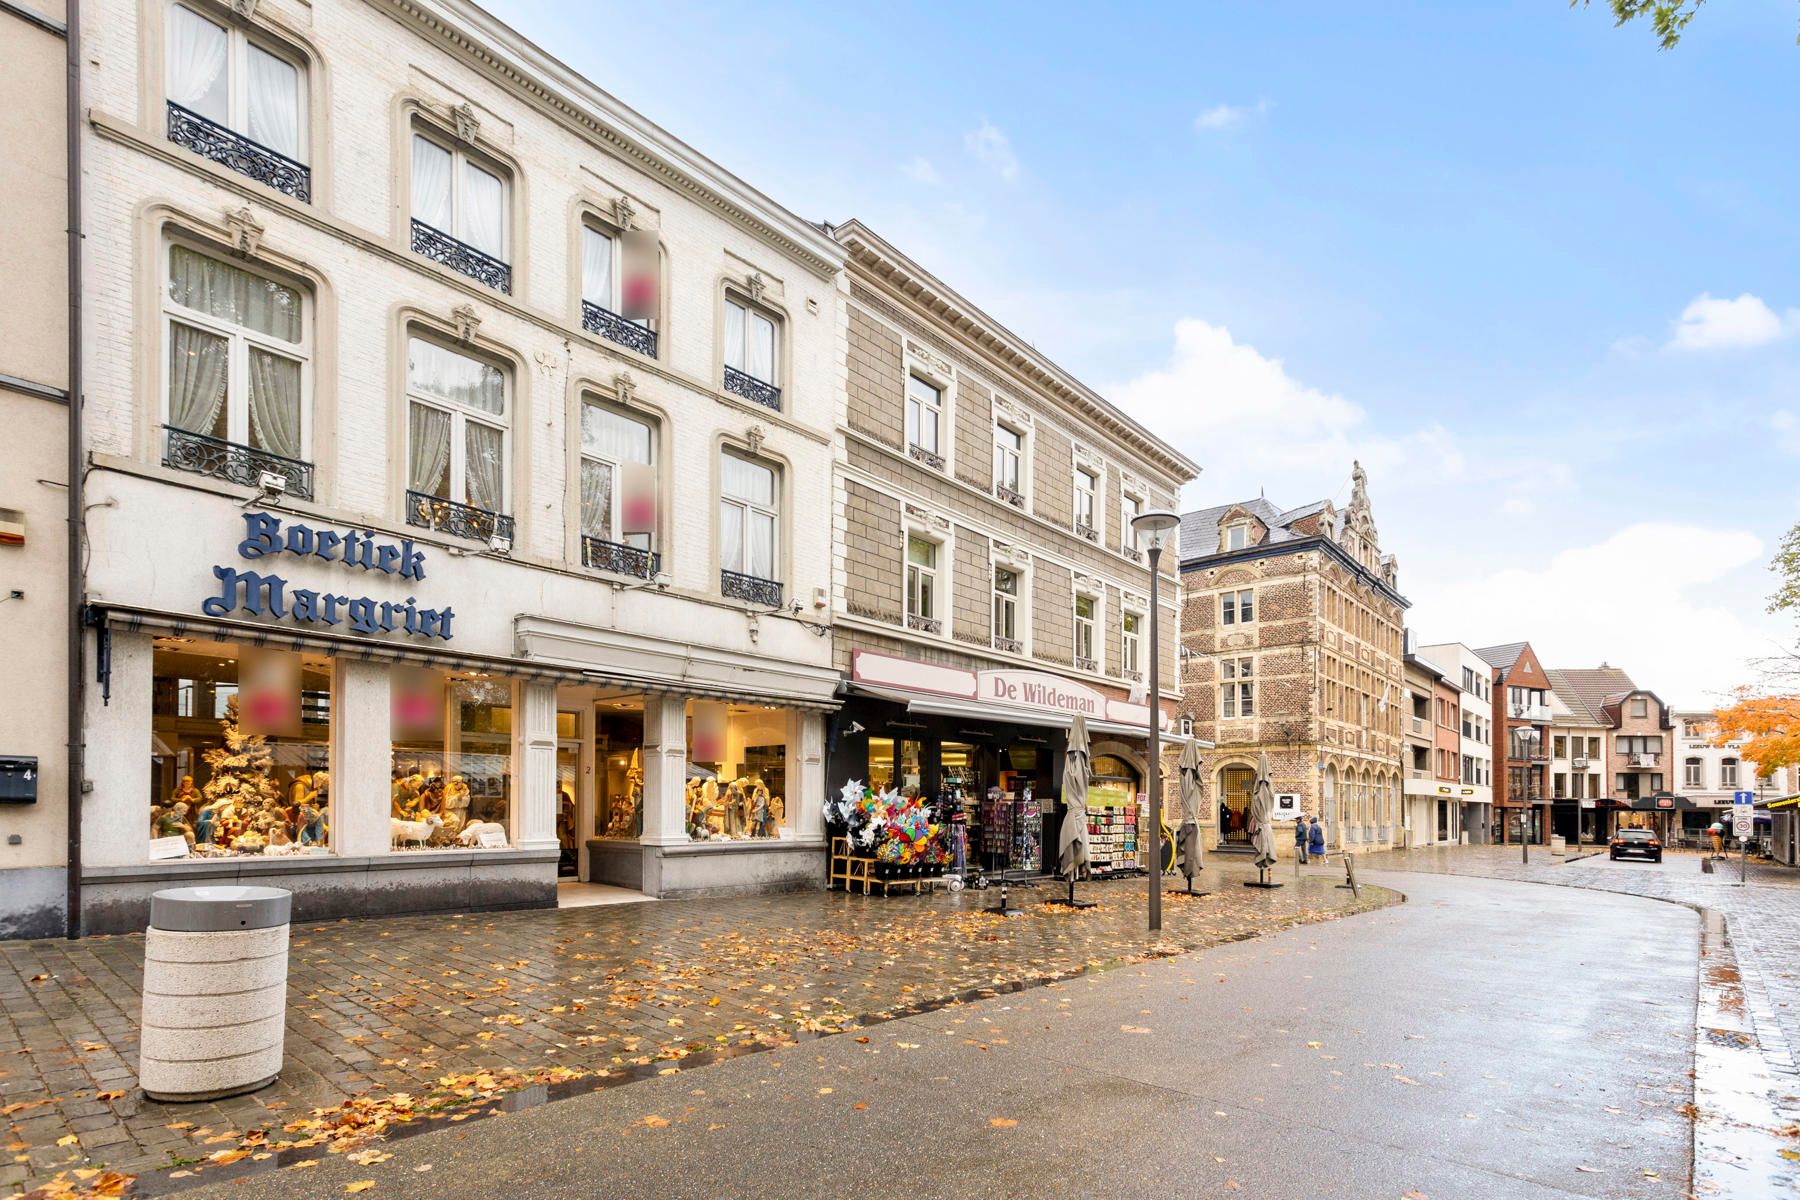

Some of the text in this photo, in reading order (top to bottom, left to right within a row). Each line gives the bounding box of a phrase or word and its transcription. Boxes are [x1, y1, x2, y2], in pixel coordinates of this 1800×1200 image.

[238, 511, 427, 581] Boetiek
[202, 565, 456, 640] Margriet
[993, 677, 1096, 714] De Wildeman
[23, 768, 32, 781] 4
[585, 766, 591, 774] 2
